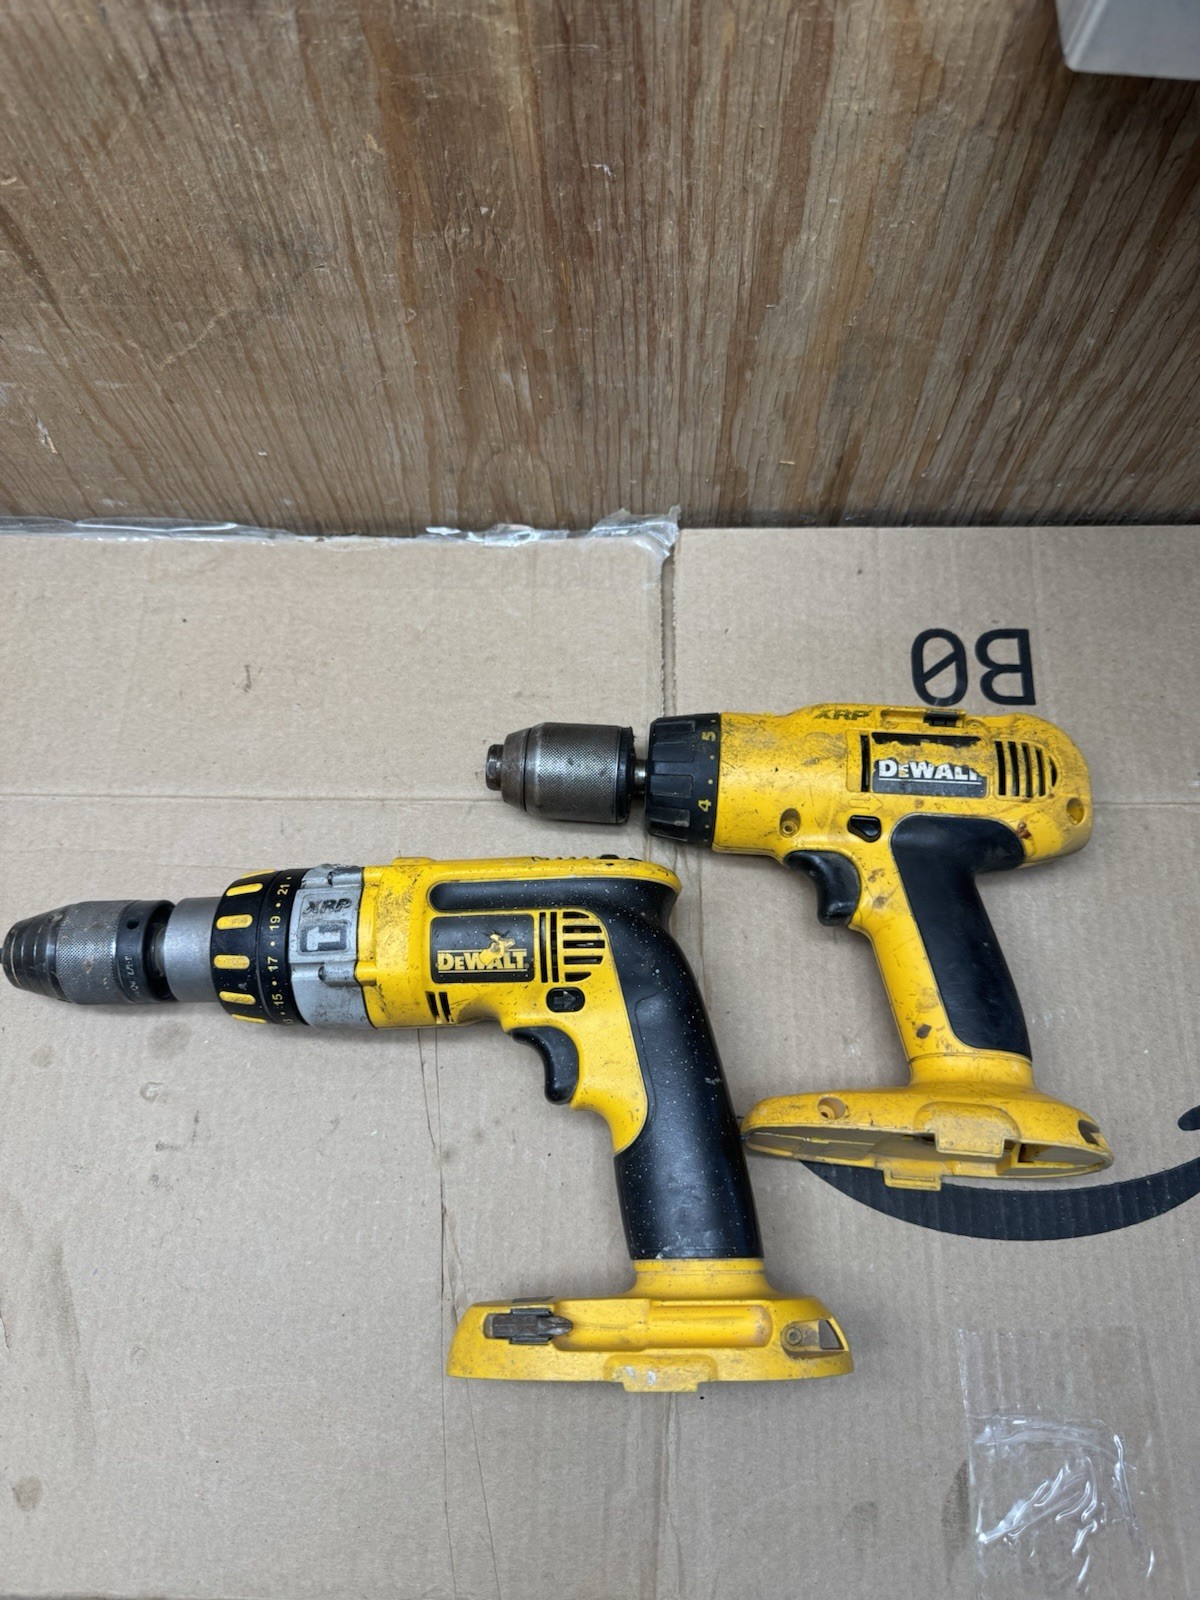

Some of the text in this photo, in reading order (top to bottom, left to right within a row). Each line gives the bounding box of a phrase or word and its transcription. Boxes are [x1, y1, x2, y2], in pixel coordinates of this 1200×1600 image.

[697, 731, 717, 813] 4 5
[267, 883, 291, 1006] 15 17 19 21
[303, 898, 352, 915] XRP
